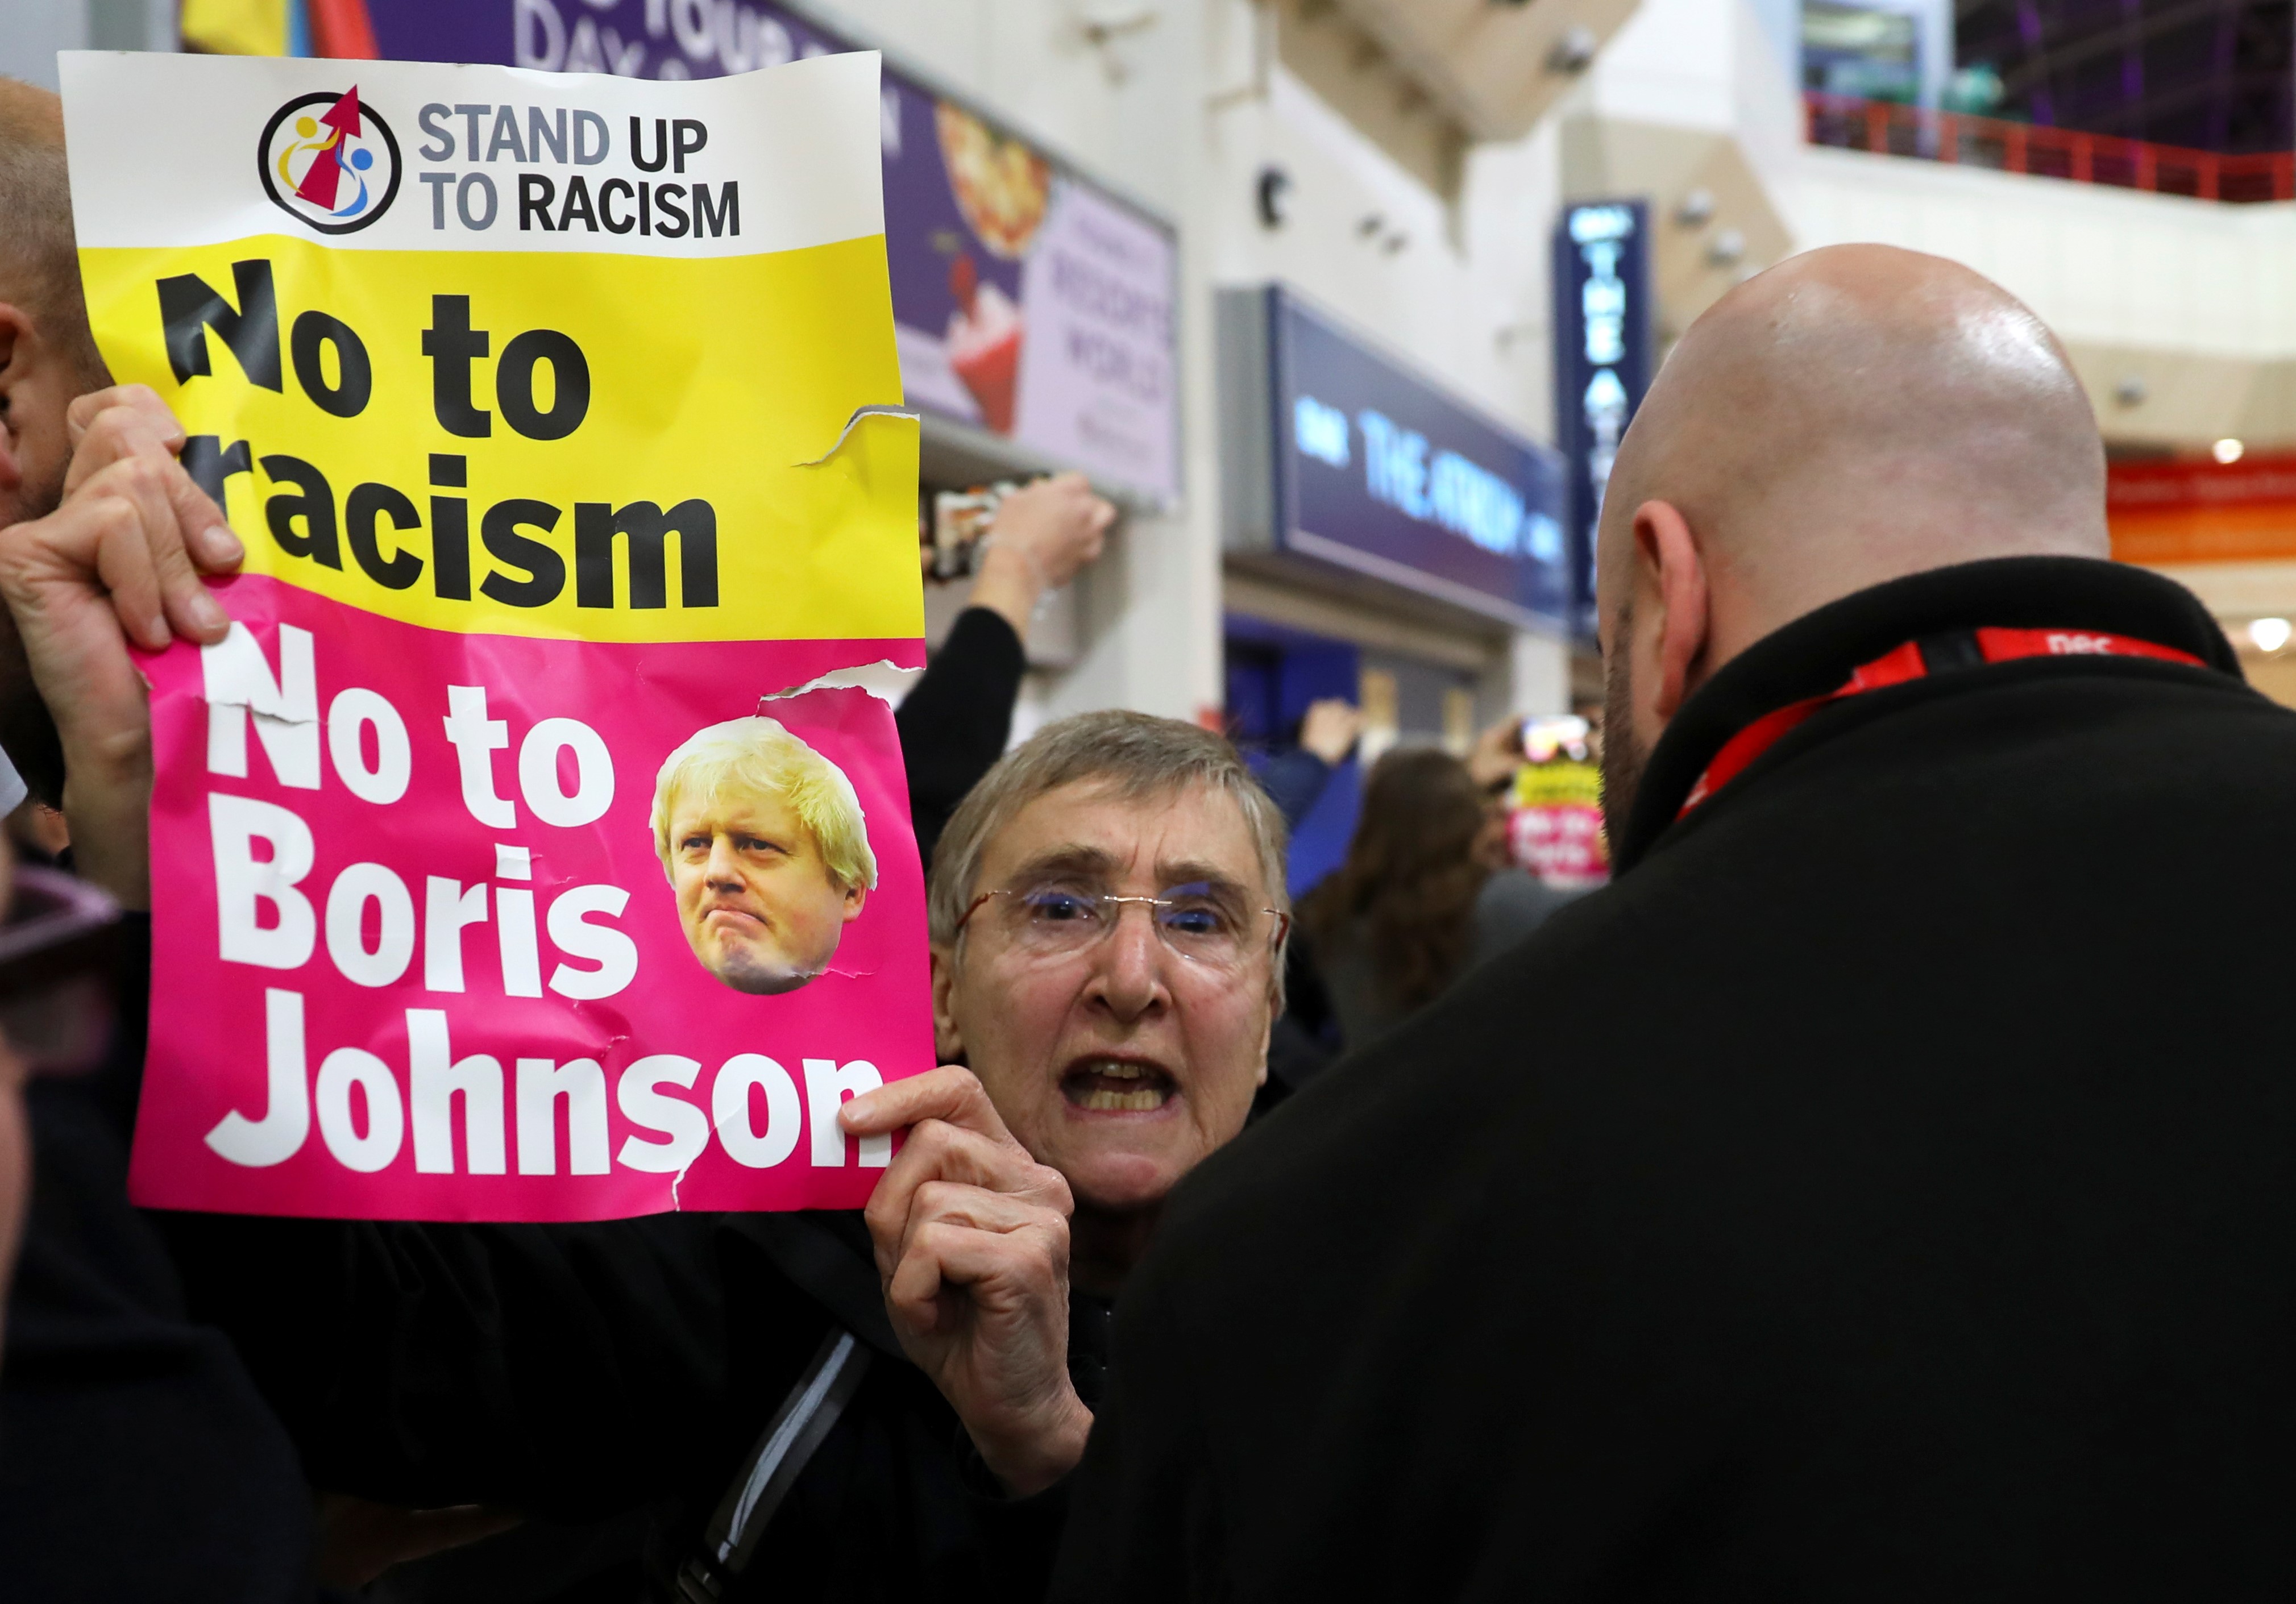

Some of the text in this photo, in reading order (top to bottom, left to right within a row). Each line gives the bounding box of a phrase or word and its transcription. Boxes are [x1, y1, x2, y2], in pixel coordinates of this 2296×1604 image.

[418, 103, 708, 173] STAND UP
[420, 172, 740, 238] TO RACISM
[156, 259, 591, 441] No to
[180, 434, 719, 609] racism
[201, 621, 615, 829] No to
[207, 791, 638, 1000] Boris
[204, 987, 891, 1175] Johnson
